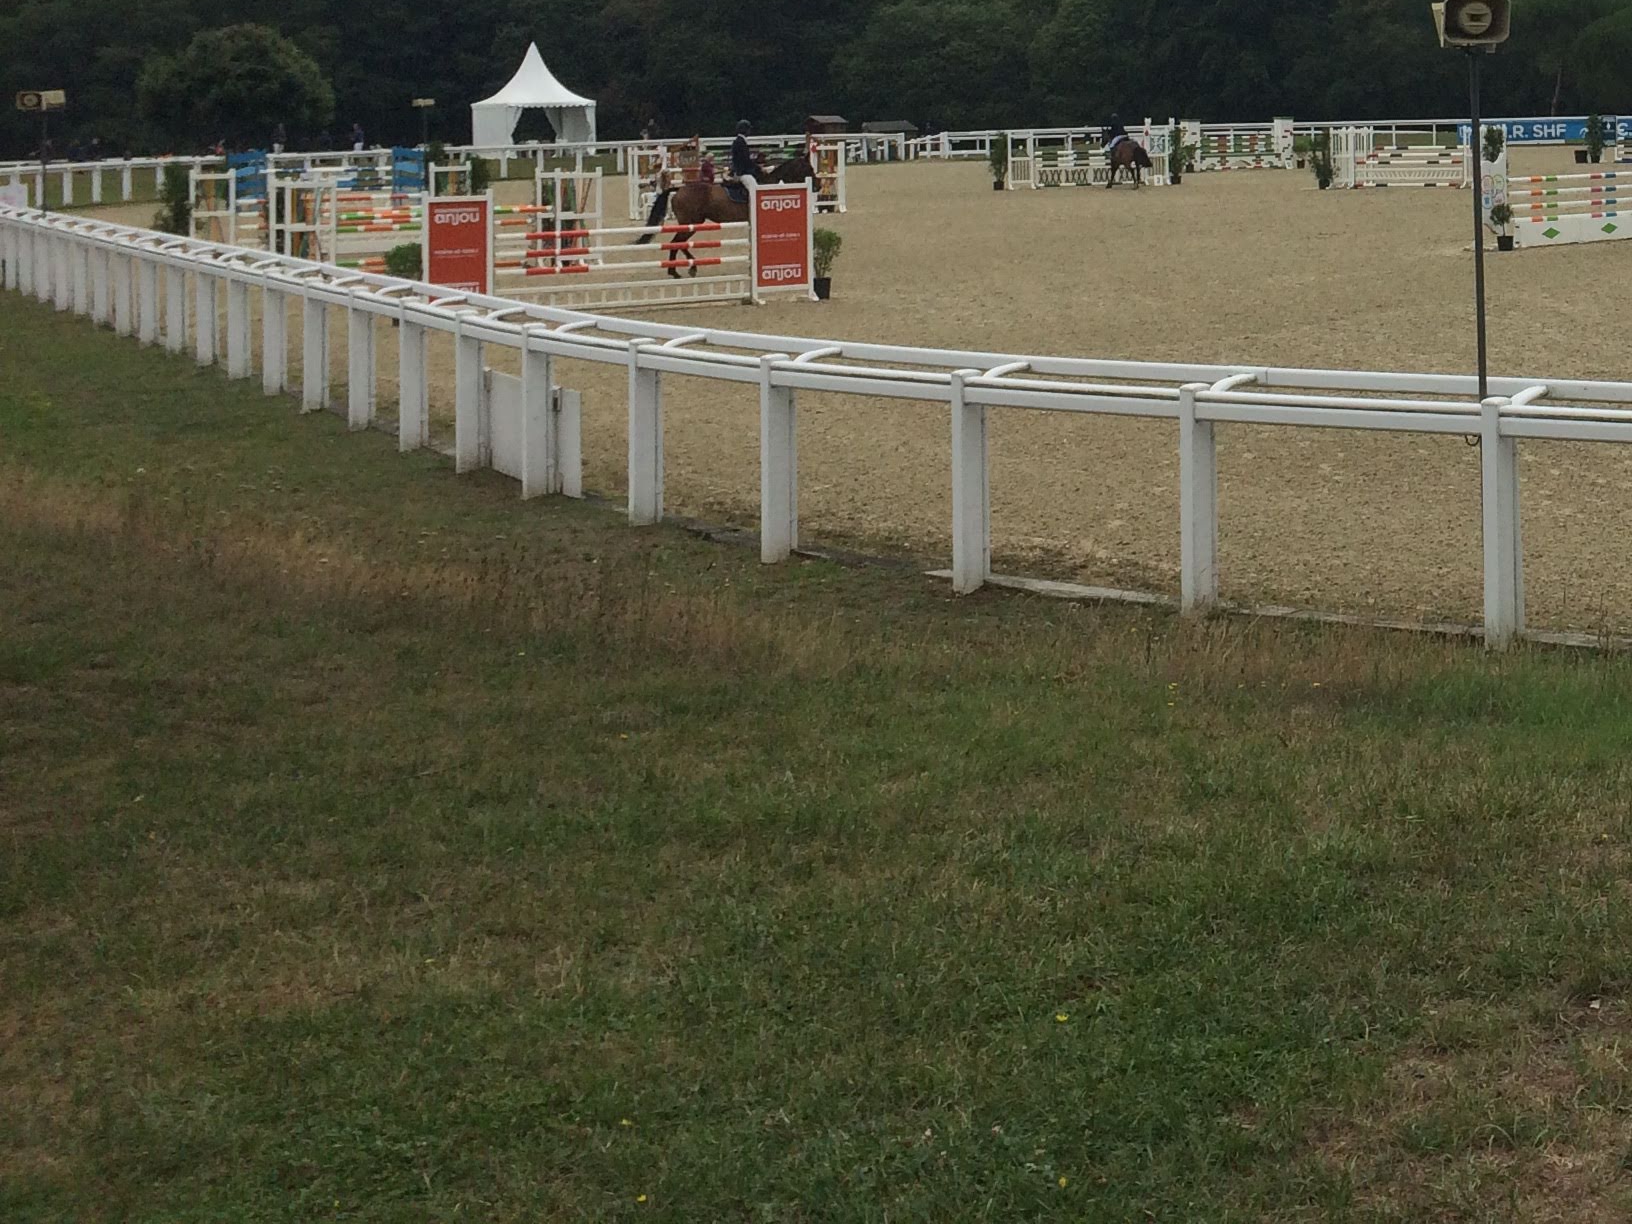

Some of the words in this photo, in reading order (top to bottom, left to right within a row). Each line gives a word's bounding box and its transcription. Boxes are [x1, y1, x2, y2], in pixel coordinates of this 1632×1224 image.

[1533, 123, 1567, 138] SHF
[760, 199, 801, 212] anjou
[433, 212, 480, 226] anjou
[761, 267, 802, 281] anjou
